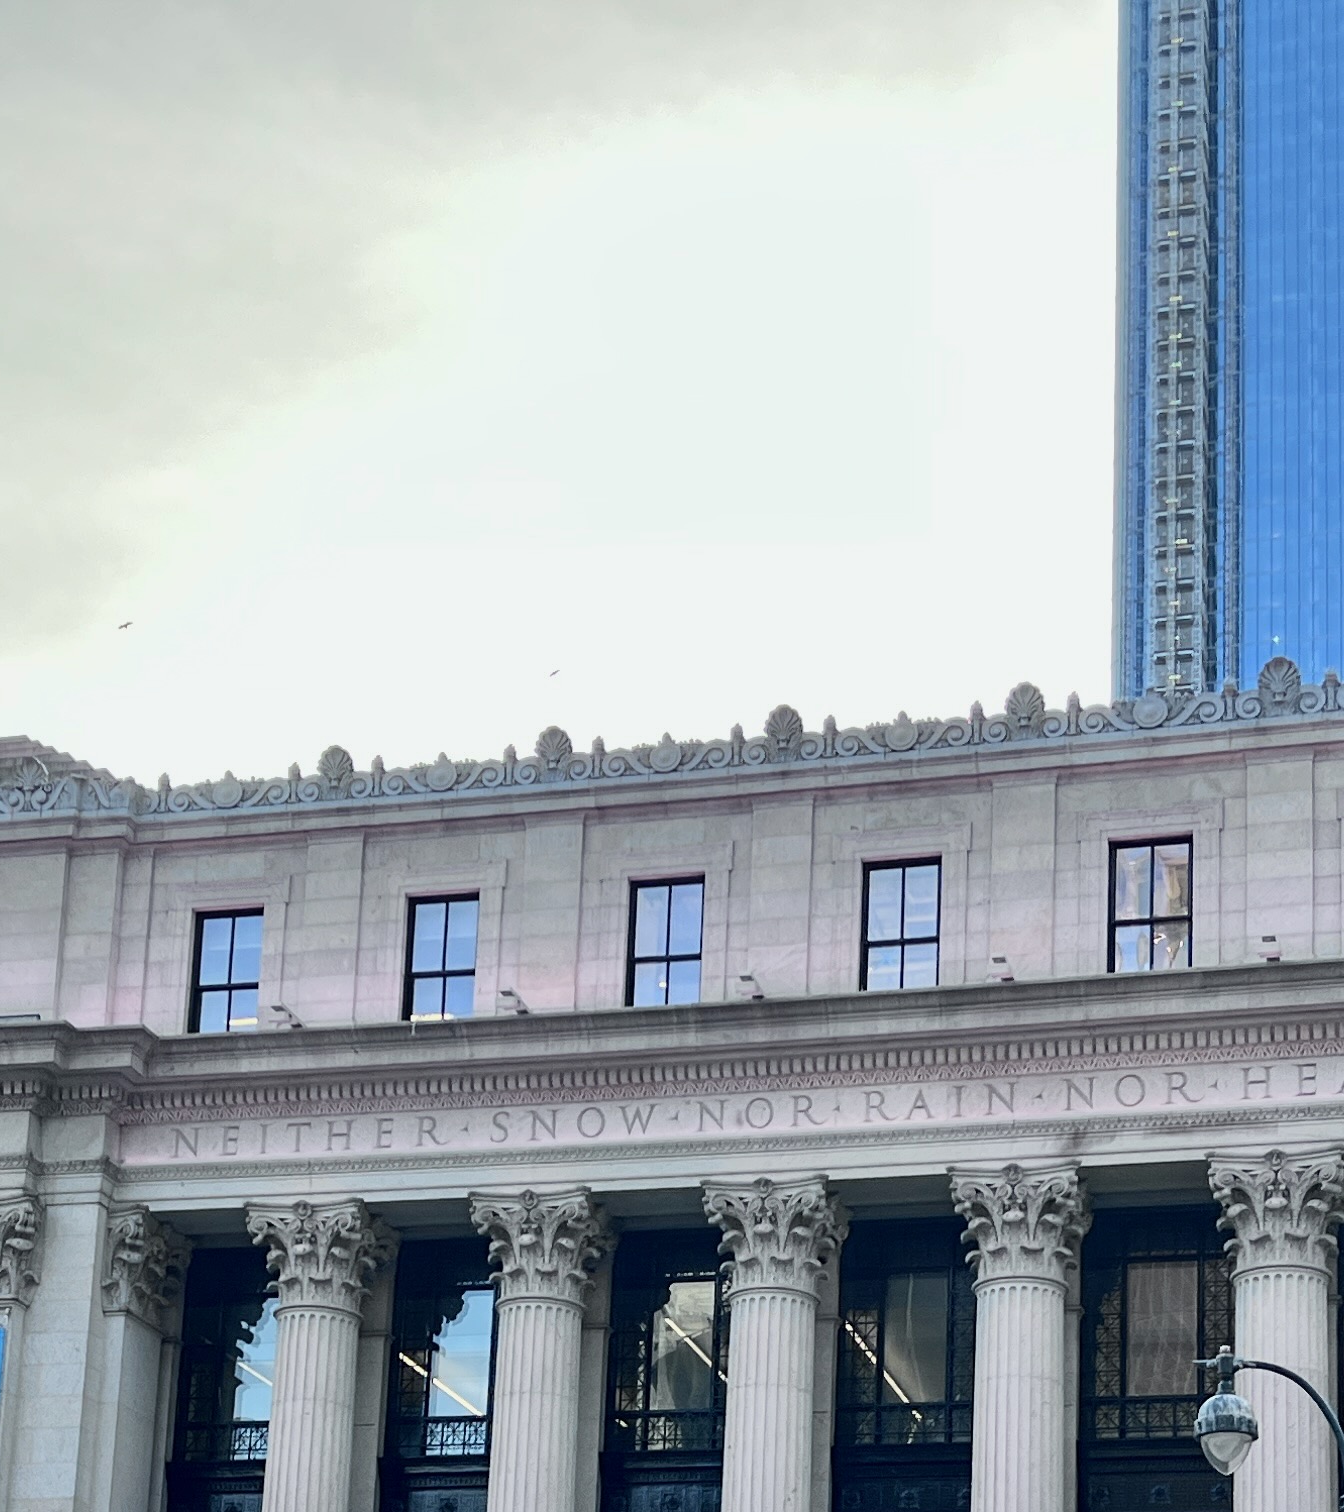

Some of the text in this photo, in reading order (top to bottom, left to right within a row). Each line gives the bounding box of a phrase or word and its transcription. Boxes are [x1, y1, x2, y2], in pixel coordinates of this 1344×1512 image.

[170, 1115, 452, 1159] NEITHER
[489, 1102, 656, 1144] SNOW
[696, 1094, 829, 1132] NOR
[862, 1082, 1019, 1123] RAIN
[1062, 1070, 1206, 1111] NOR
